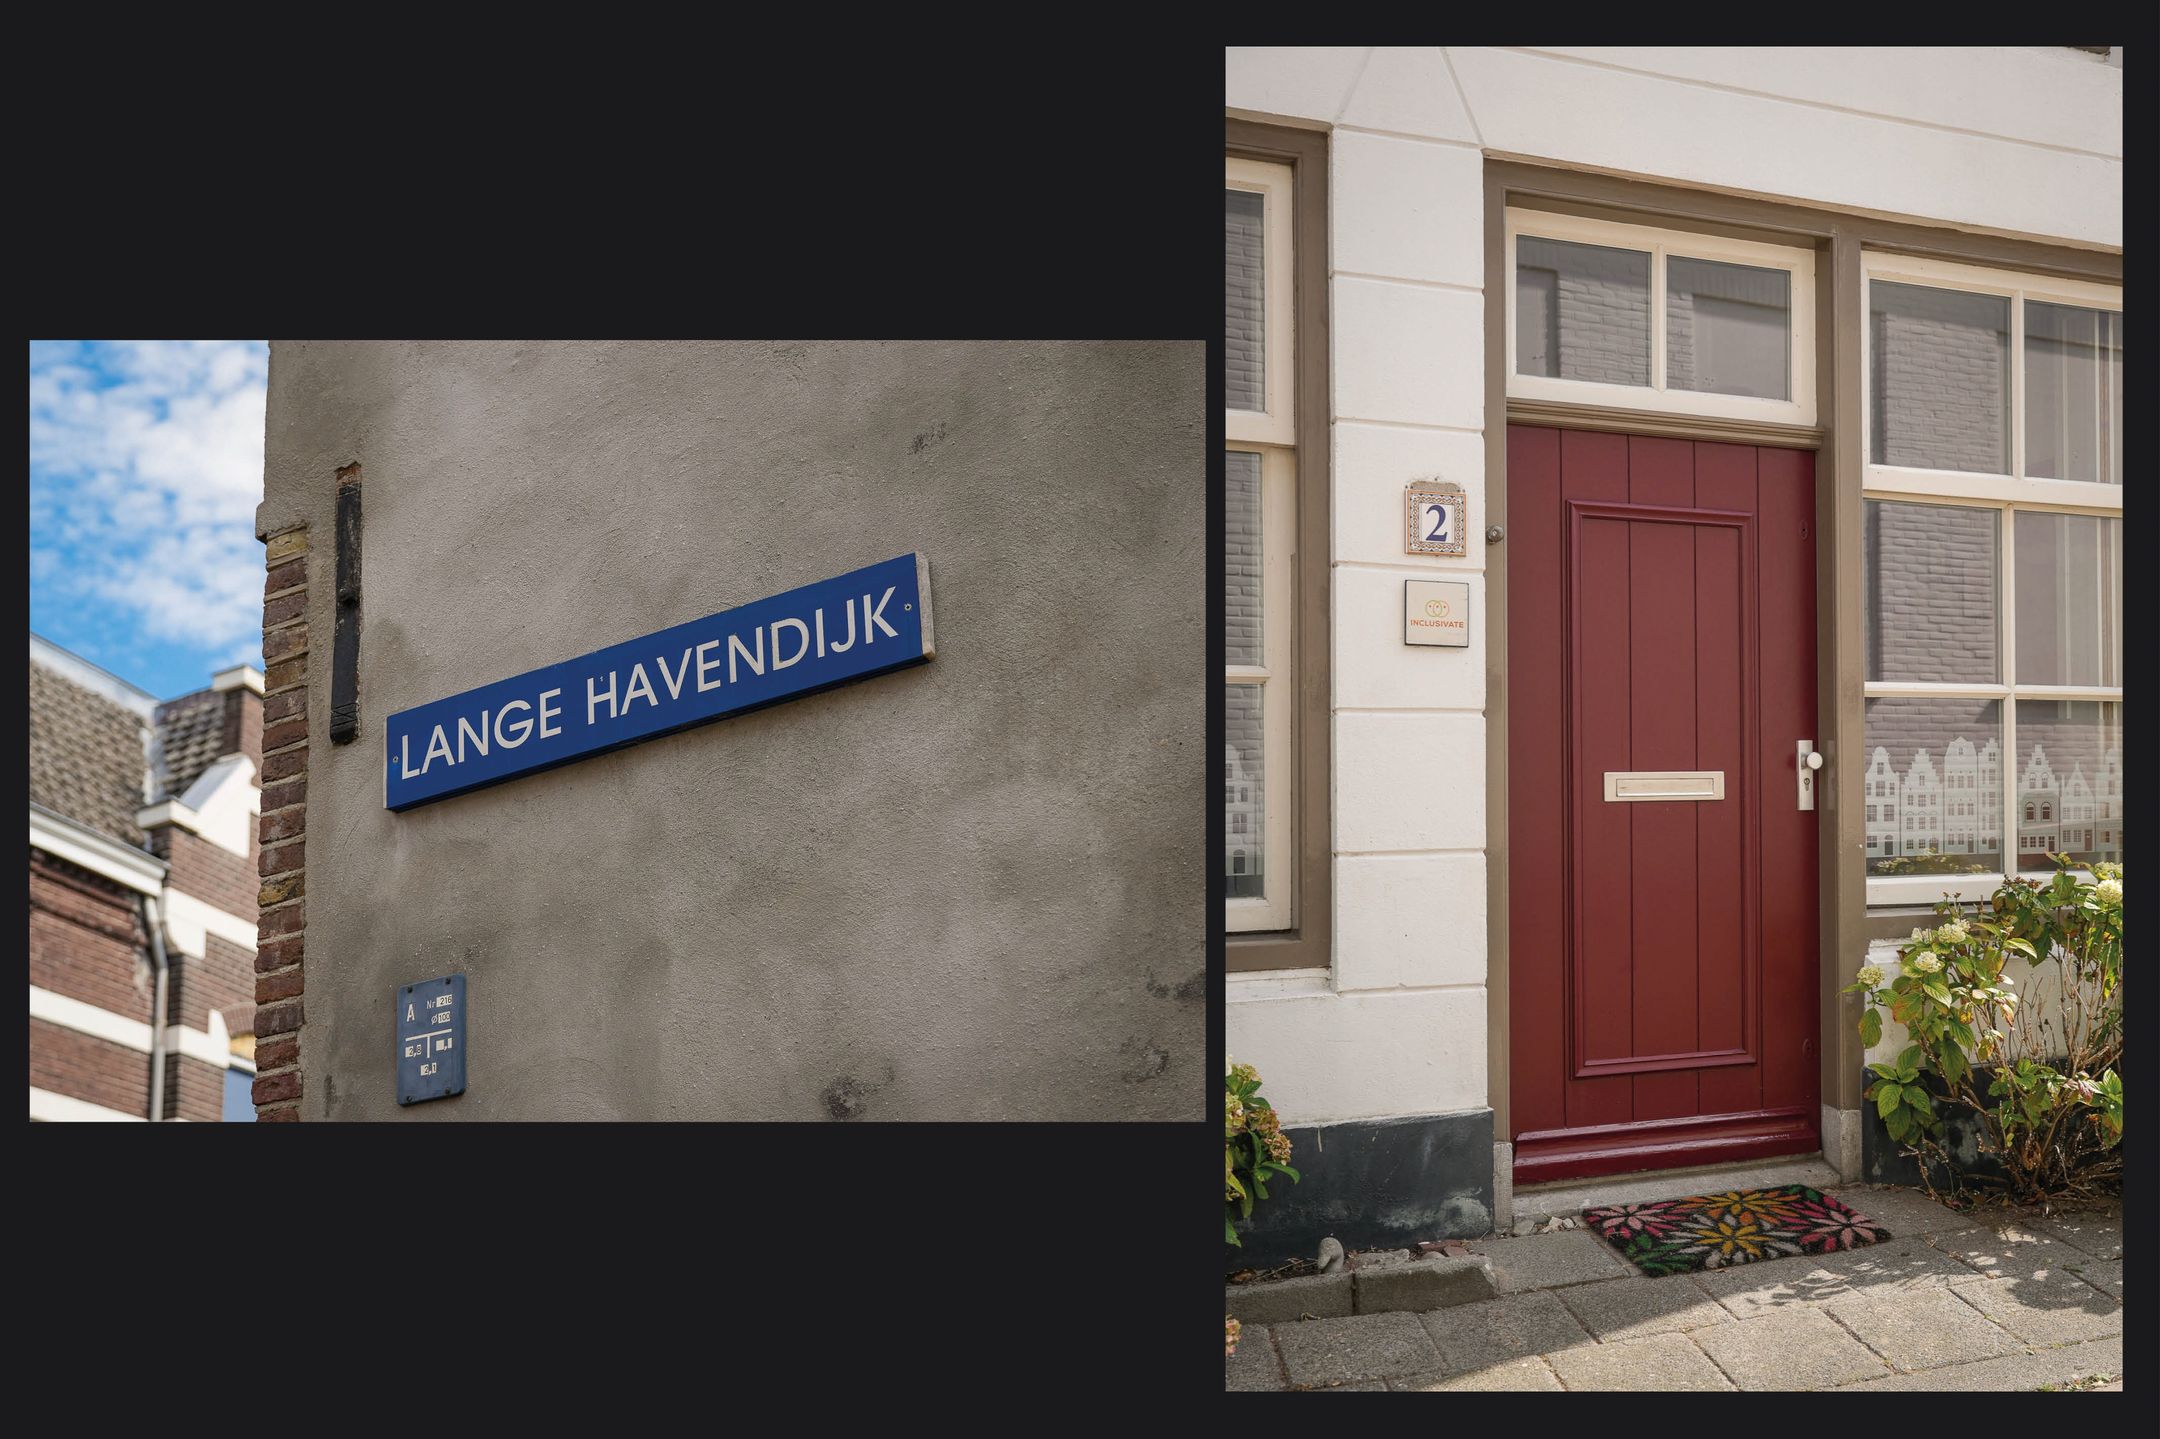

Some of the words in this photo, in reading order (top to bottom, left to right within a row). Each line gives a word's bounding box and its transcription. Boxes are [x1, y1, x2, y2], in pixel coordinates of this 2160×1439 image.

[1425, 504, 1448, 542] 2
[1410, 619, 1464, 629] INCLUSIVATE
[401, 687, 562, 780] LANGE
[586, 586, 900, 725] HAVENDIJK
[440, 996, 452, 1005] 216
[407, 1004, 415, 1022] A
